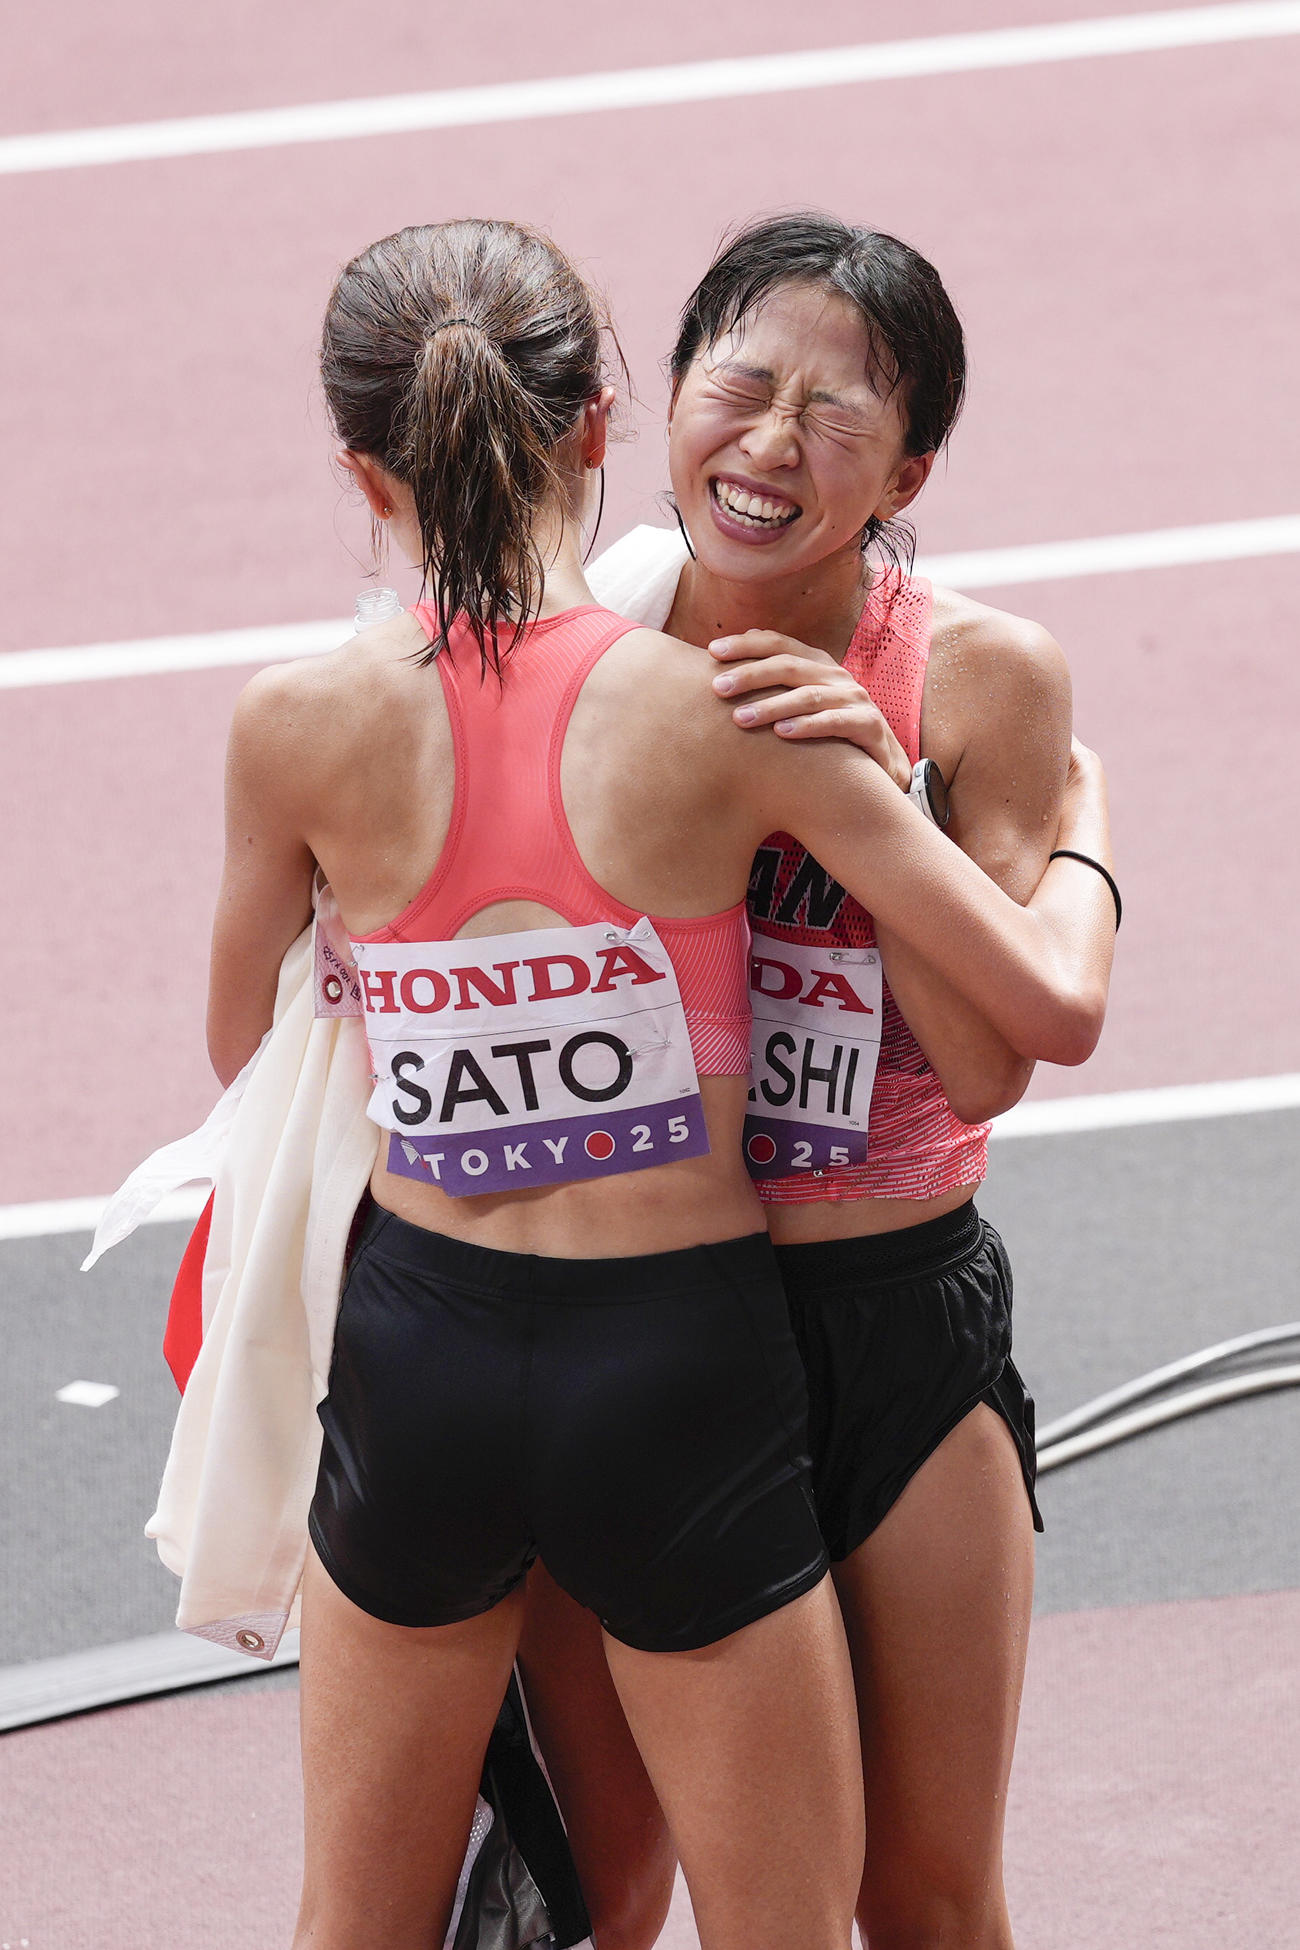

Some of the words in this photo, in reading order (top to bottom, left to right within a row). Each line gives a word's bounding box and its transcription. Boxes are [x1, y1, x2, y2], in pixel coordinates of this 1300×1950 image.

[359, 945, 667, 1014] HONDA
[391, 1031, 633, 1126] SATO
[748, 1032, 860, 1116] SHI
[630, 1115, 689, 1152] 25
[791, 1141, 850, 1168] 25
